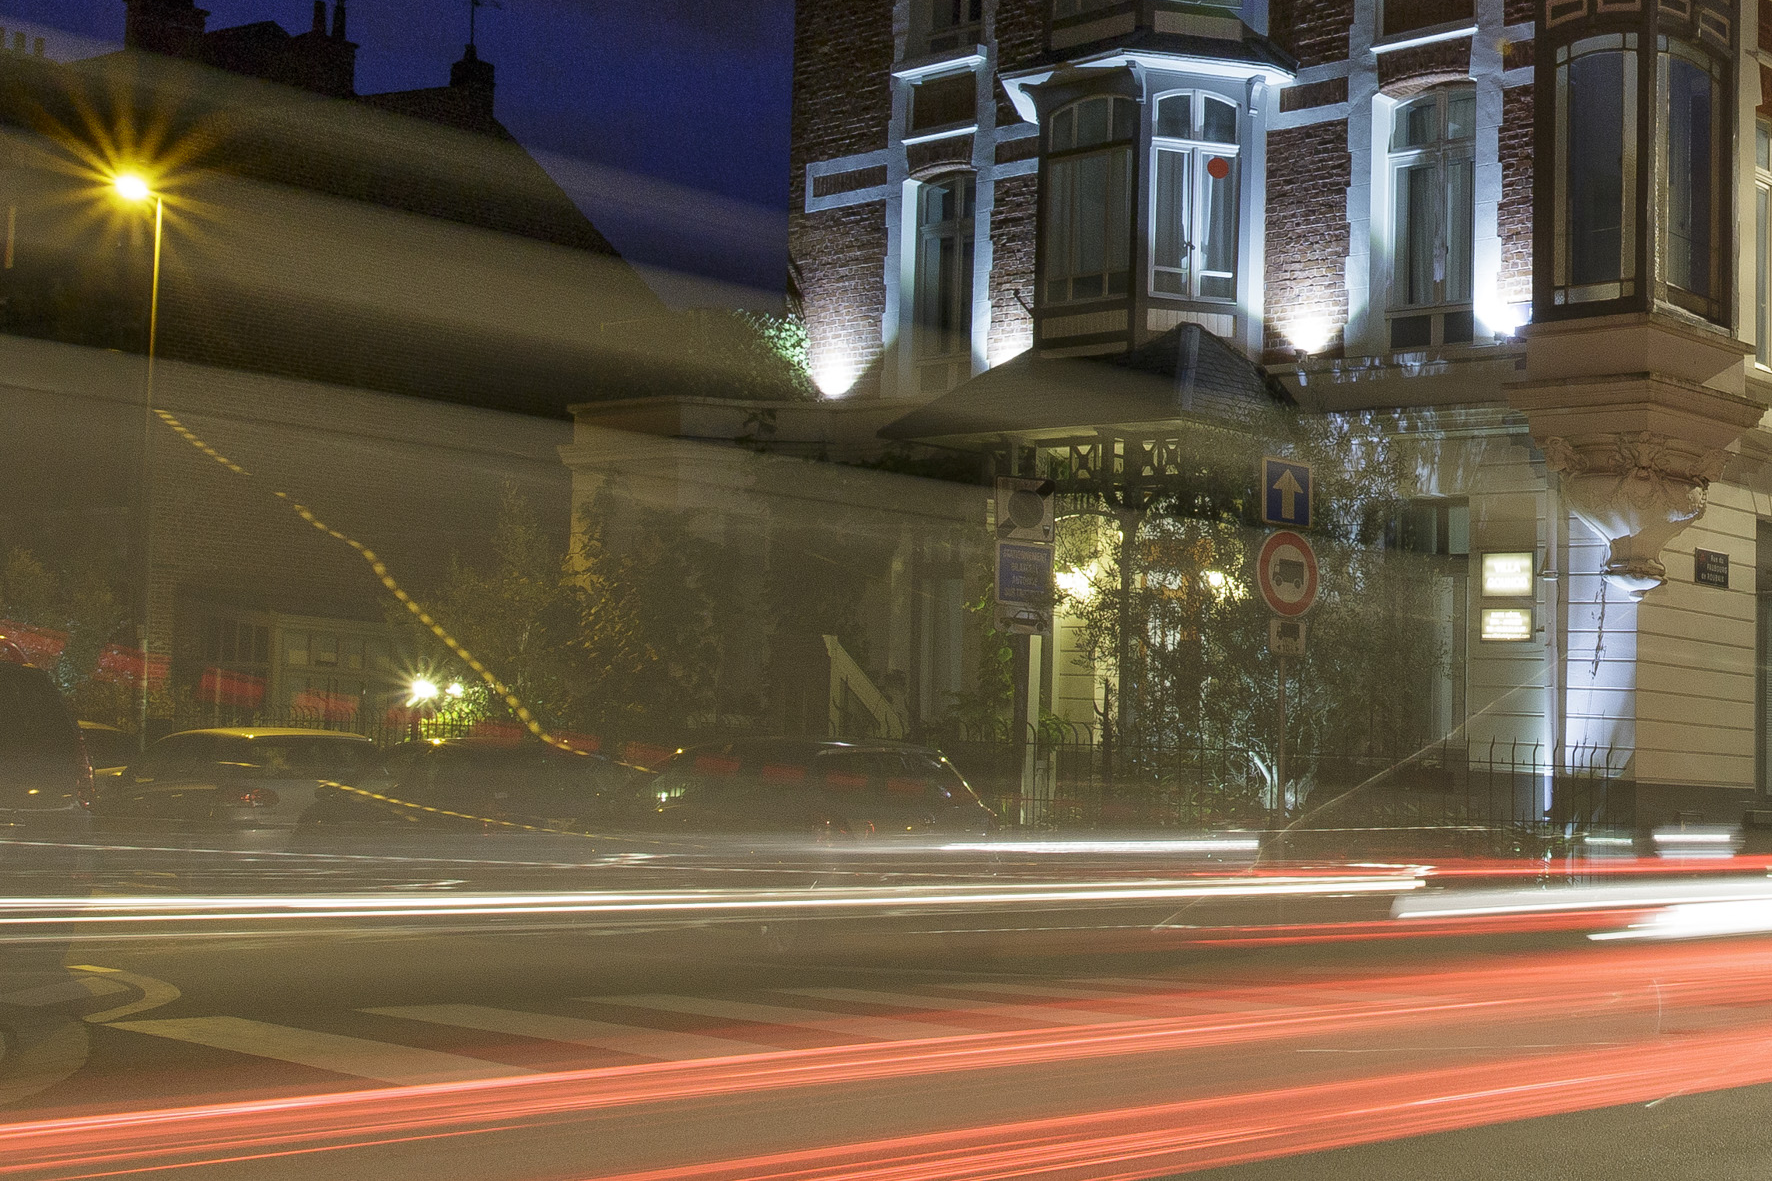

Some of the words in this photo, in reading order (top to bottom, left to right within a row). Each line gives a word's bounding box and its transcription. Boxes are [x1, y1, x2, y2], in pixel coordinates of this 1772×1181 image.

[1493, 561, 1521, 573] VILLA
[1706, 563, 1727, 574] FAUBOURG
[1707, 573, 1724, 582] ROUBAIX
